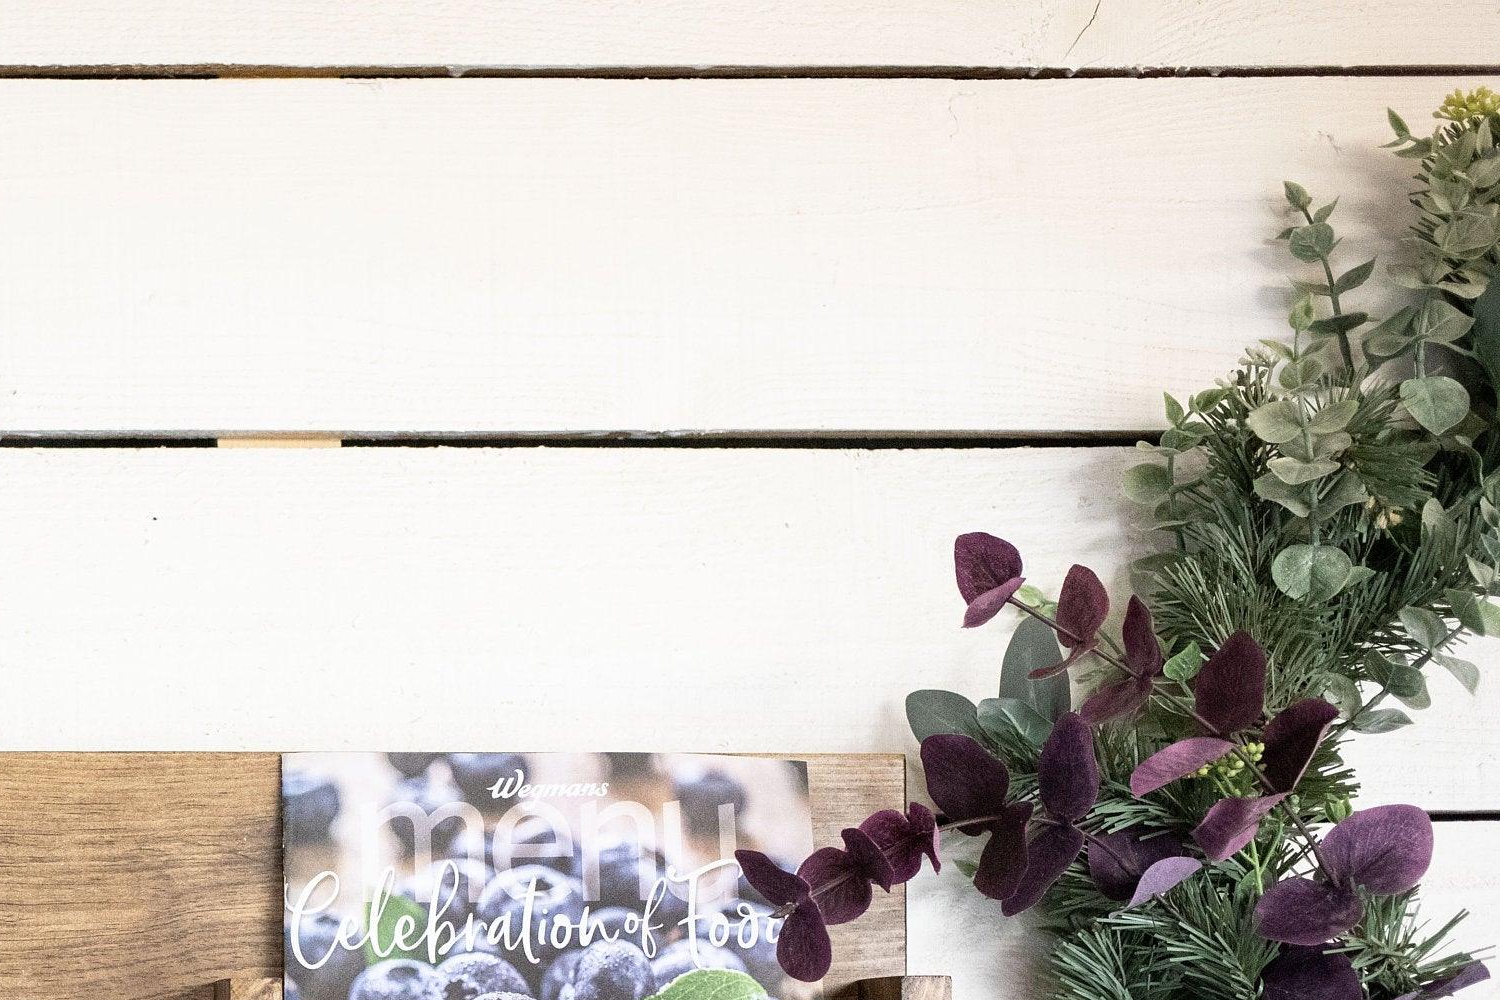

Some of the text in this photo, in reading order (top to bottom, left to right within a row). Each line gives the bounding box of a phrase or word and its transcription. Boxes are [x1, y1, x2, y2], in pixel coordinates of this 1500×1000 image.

[486, 769, 609, 809] Wegmans
[362, 798, 739, 904] menu
[284, 859, 619, 970] Celebration
[624, 877, 663, 958] of
